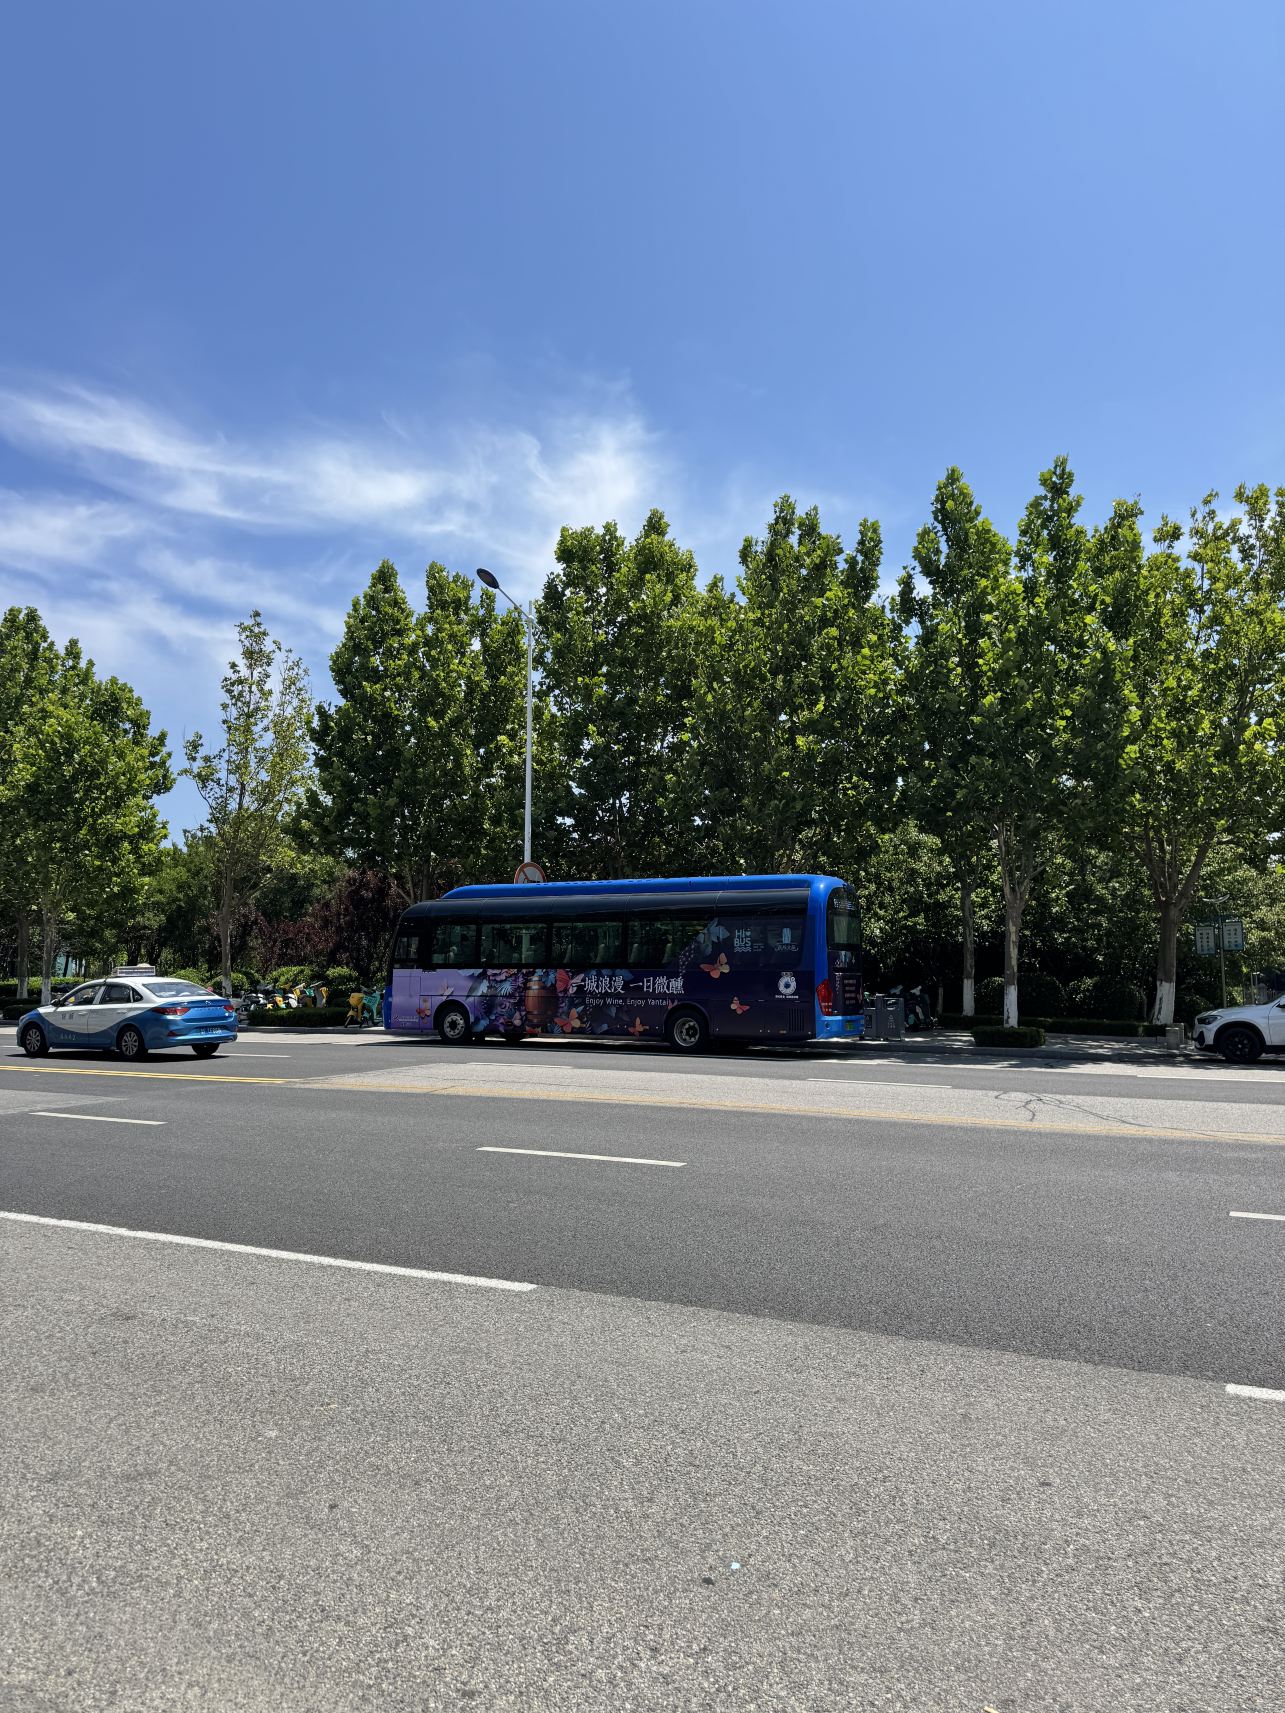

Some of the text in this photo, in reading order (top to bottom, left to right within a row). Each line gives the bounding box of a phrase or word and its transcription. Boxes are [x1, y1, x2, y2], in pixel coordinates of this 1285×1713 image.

[734, 937, 751, 946] BUS
[572, 975, 685, 994] 一城浪漫 一日微醺
[585, 997, 604, 1006] Enjoy
[606, 997, 625, 1006] Wine,
[627, 998, 646, 1007] Enjoy
